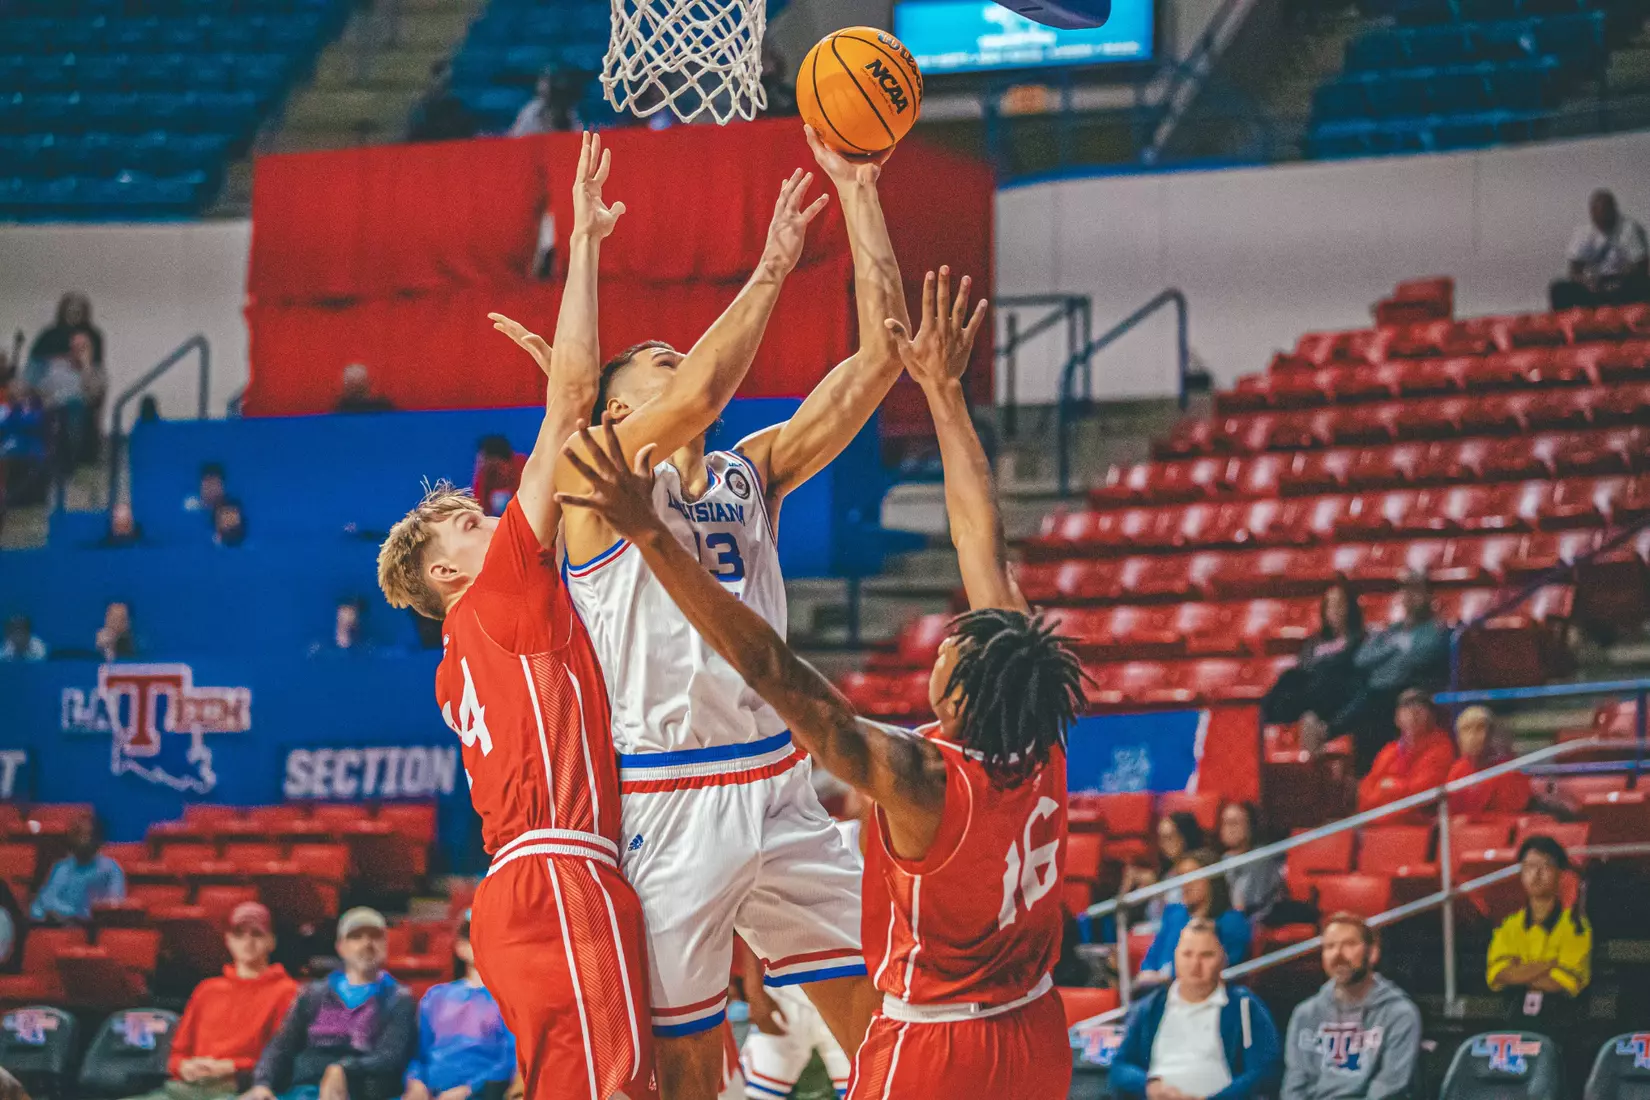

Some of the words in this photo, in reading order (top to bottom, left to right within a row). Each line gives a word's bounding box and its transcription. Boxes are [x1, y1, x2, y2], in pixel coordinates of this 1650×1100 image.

[865, 58, 908, 115] NCAA
[284, 746, 458, 796] SECTION
[998, 796, 1059, 930] 16
